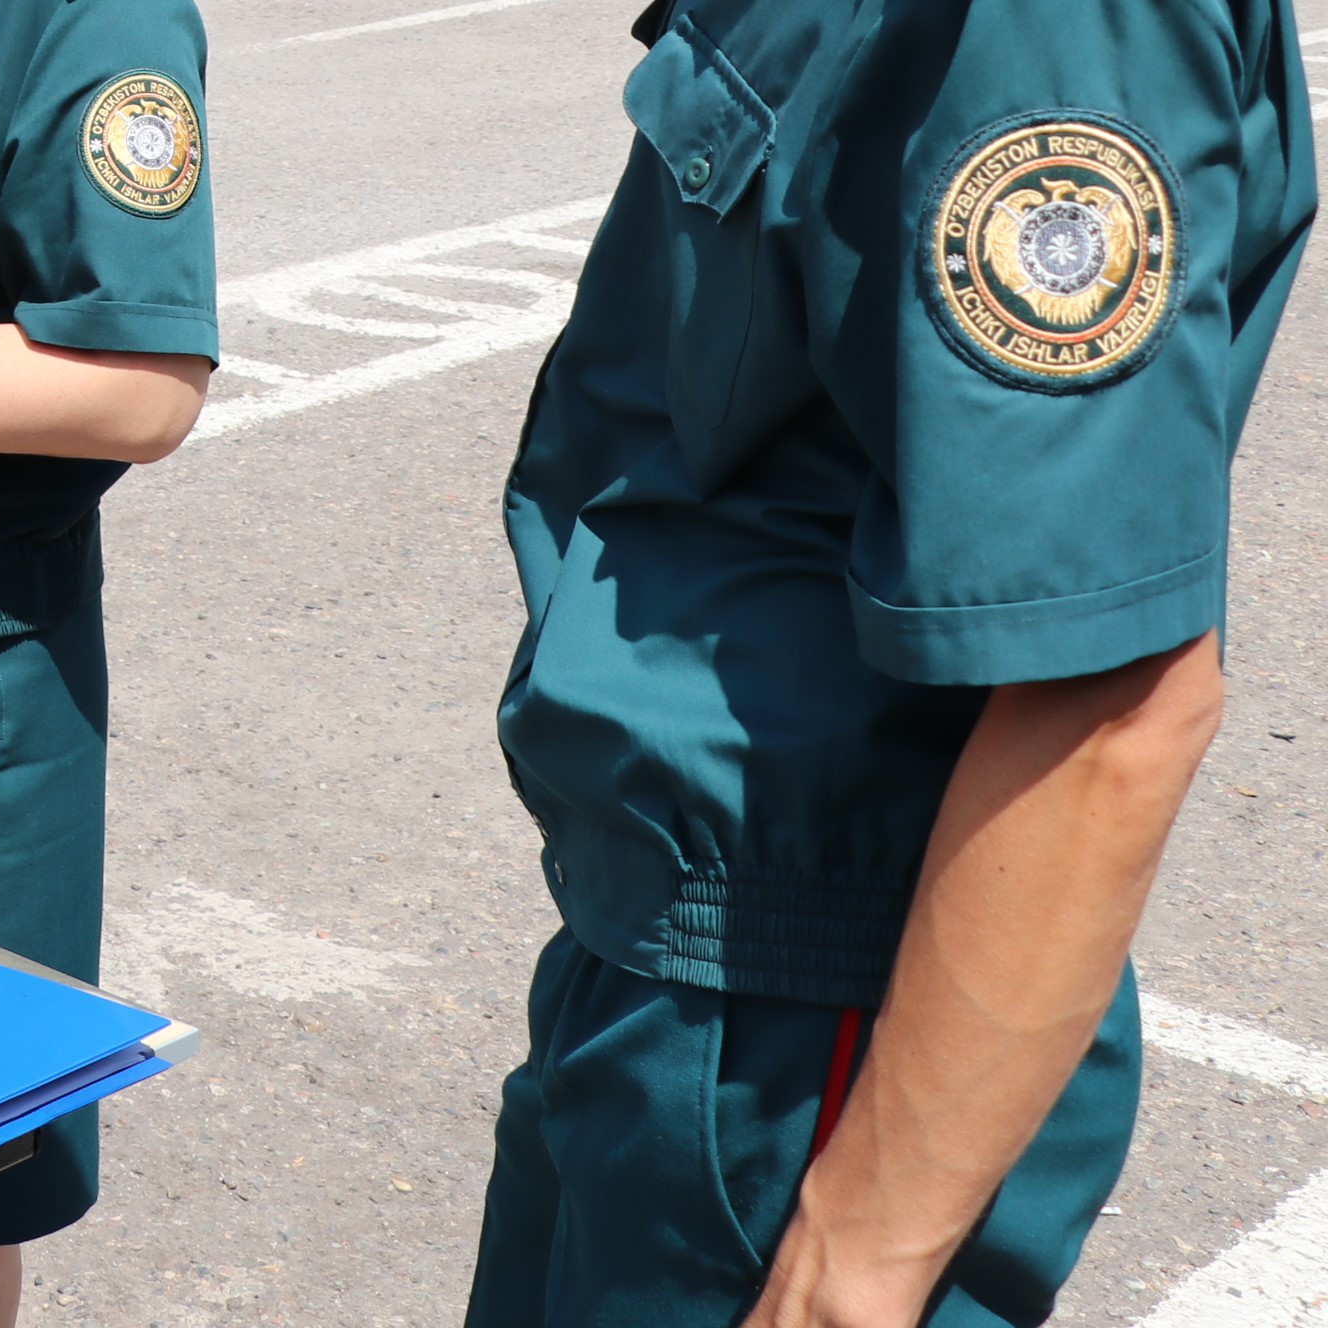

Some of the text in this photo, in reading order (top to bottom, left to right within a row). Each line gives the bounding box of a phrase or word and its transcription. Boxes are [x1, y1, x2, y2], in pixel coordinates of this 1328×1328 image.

[93, 82, 146, 134] O'ZBEKISTON
[95, 157, 118, 186] ICHKI
[120, 185, 161, 205] ISHLAR
[946, 136, 1160, 239] O'ZBEKISTON RESPUBLIKASI
[957, 270, 1159, 363] ICHKI ISHLAR VAZIRLIGI
